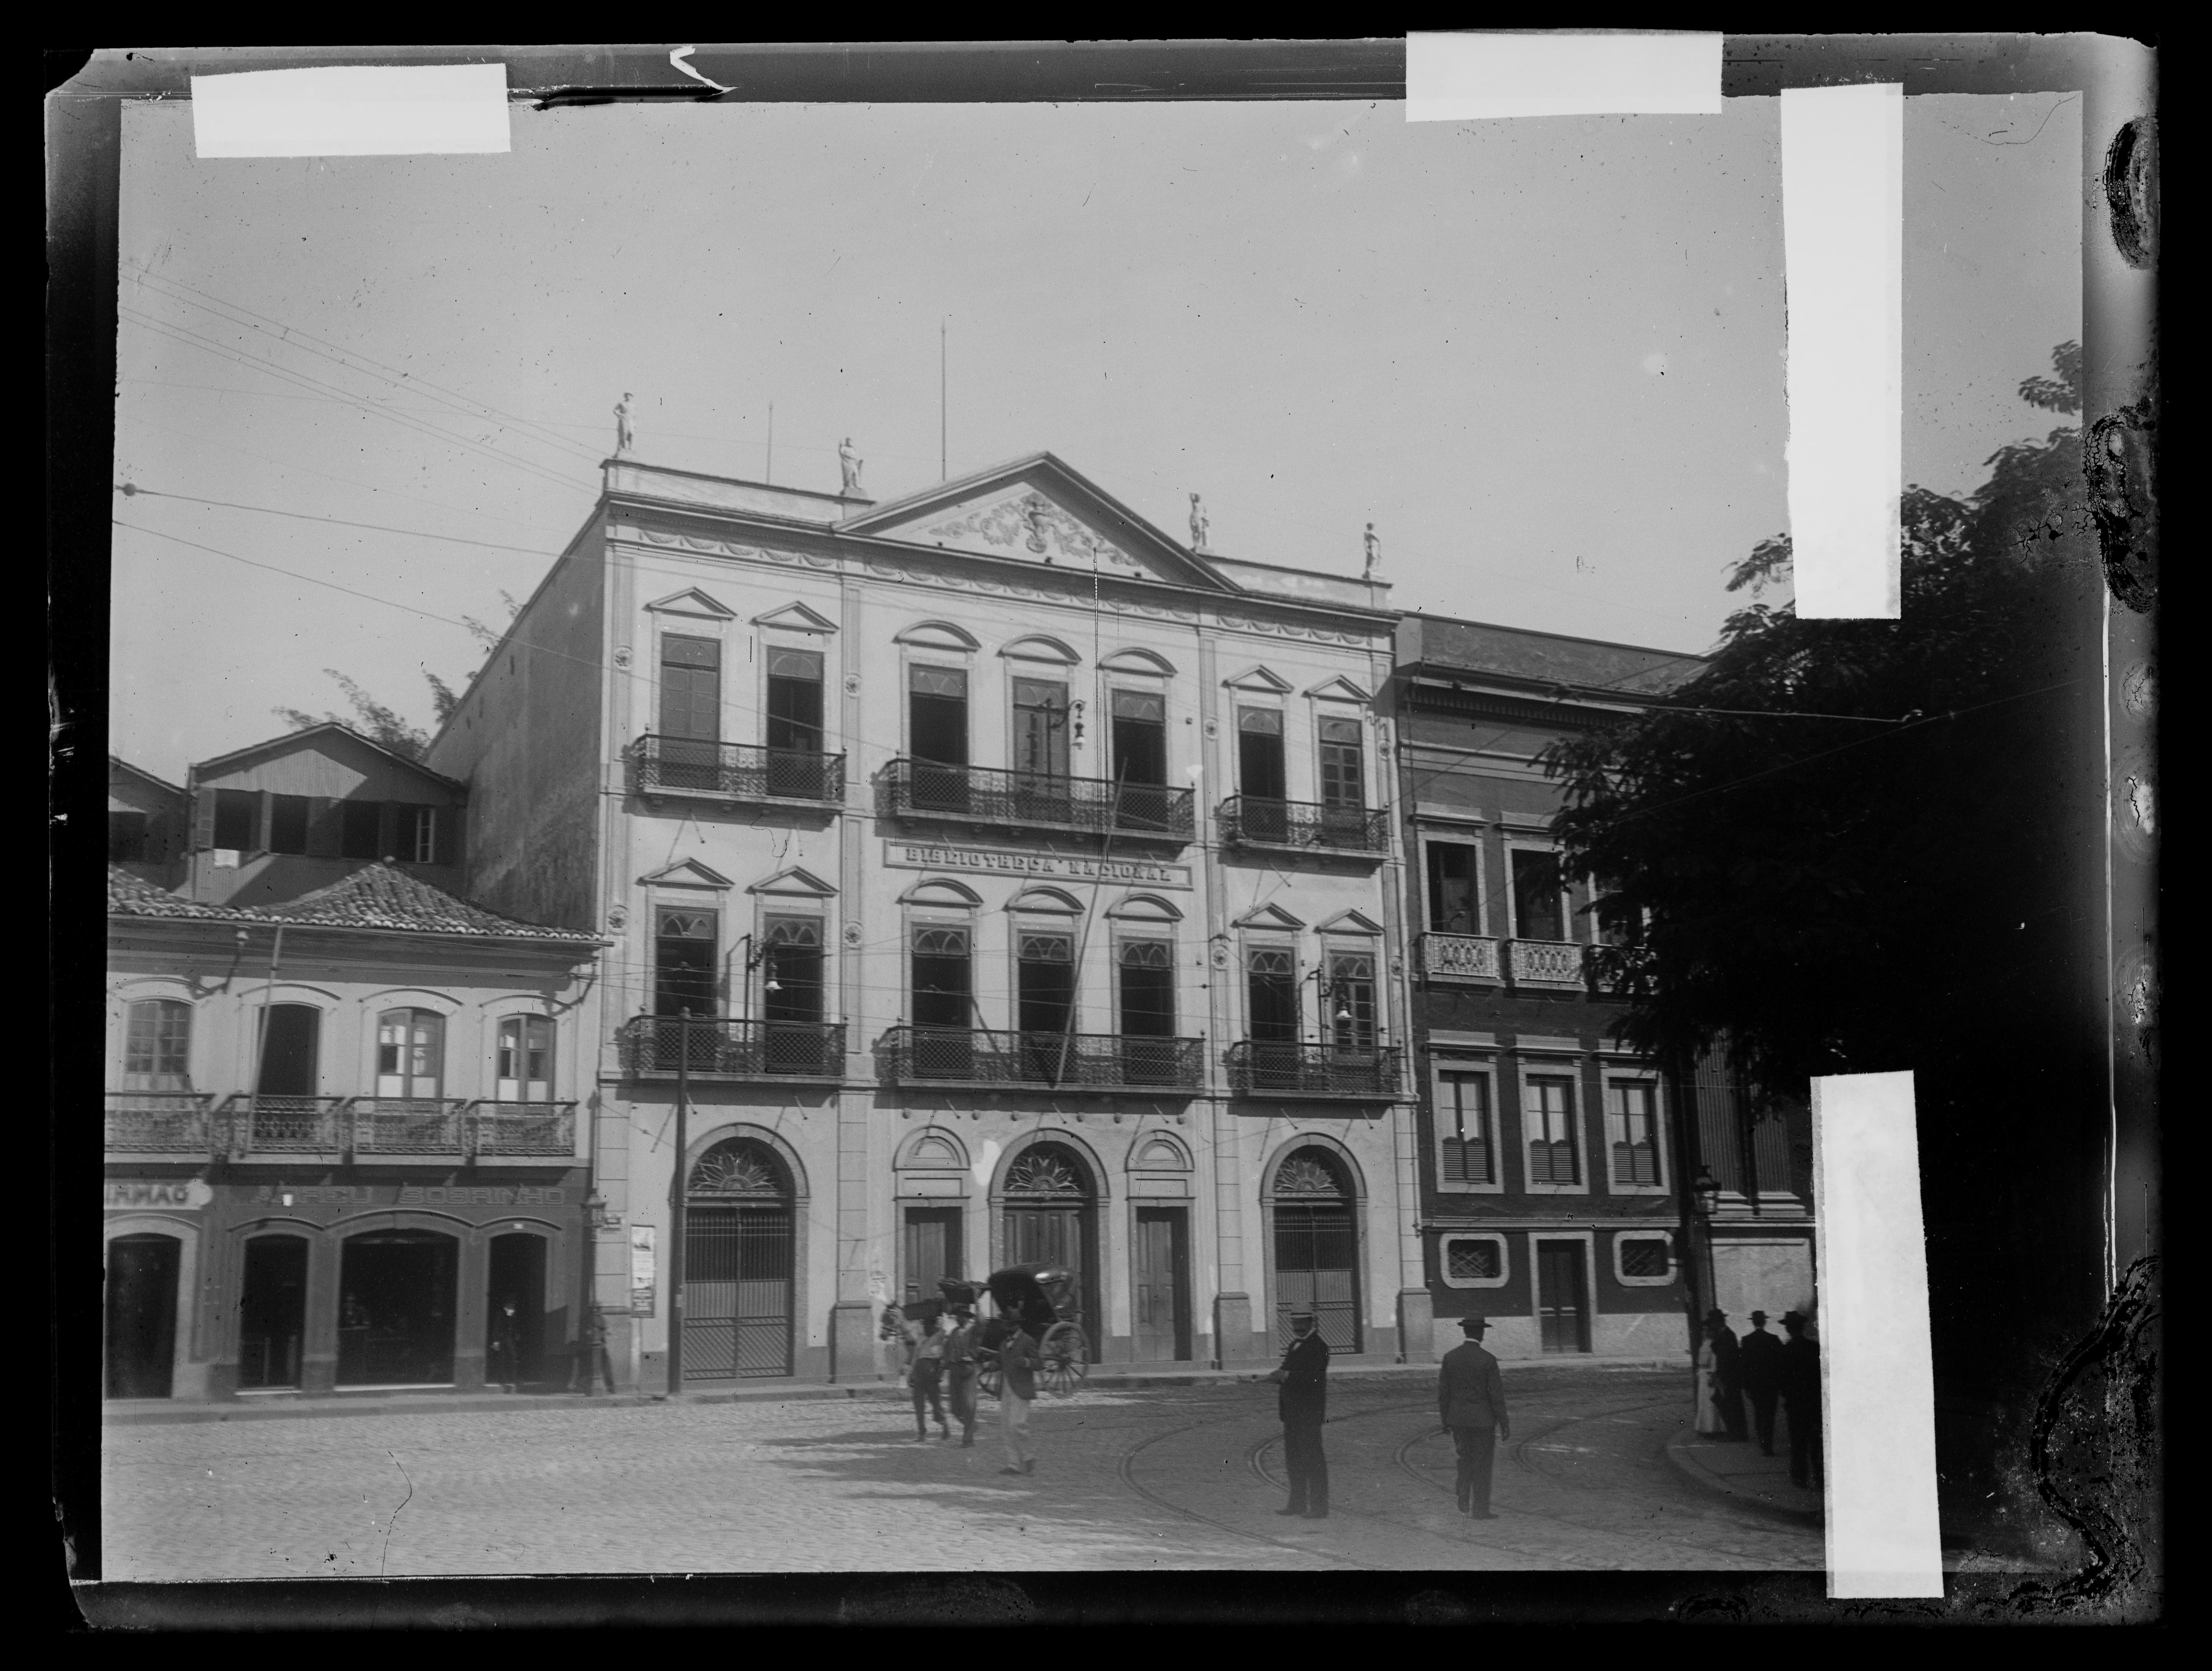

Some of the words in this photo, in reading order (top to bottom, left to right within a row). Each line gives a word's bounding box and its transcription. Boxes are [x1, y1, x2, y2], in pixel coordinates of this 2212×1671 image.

[906, 848, 1054, 872] BIBLIOTHECA
[1069, 861, 1171, 882] NACIONAL
[400, 1187, 564, 1204] SOBRINHO
